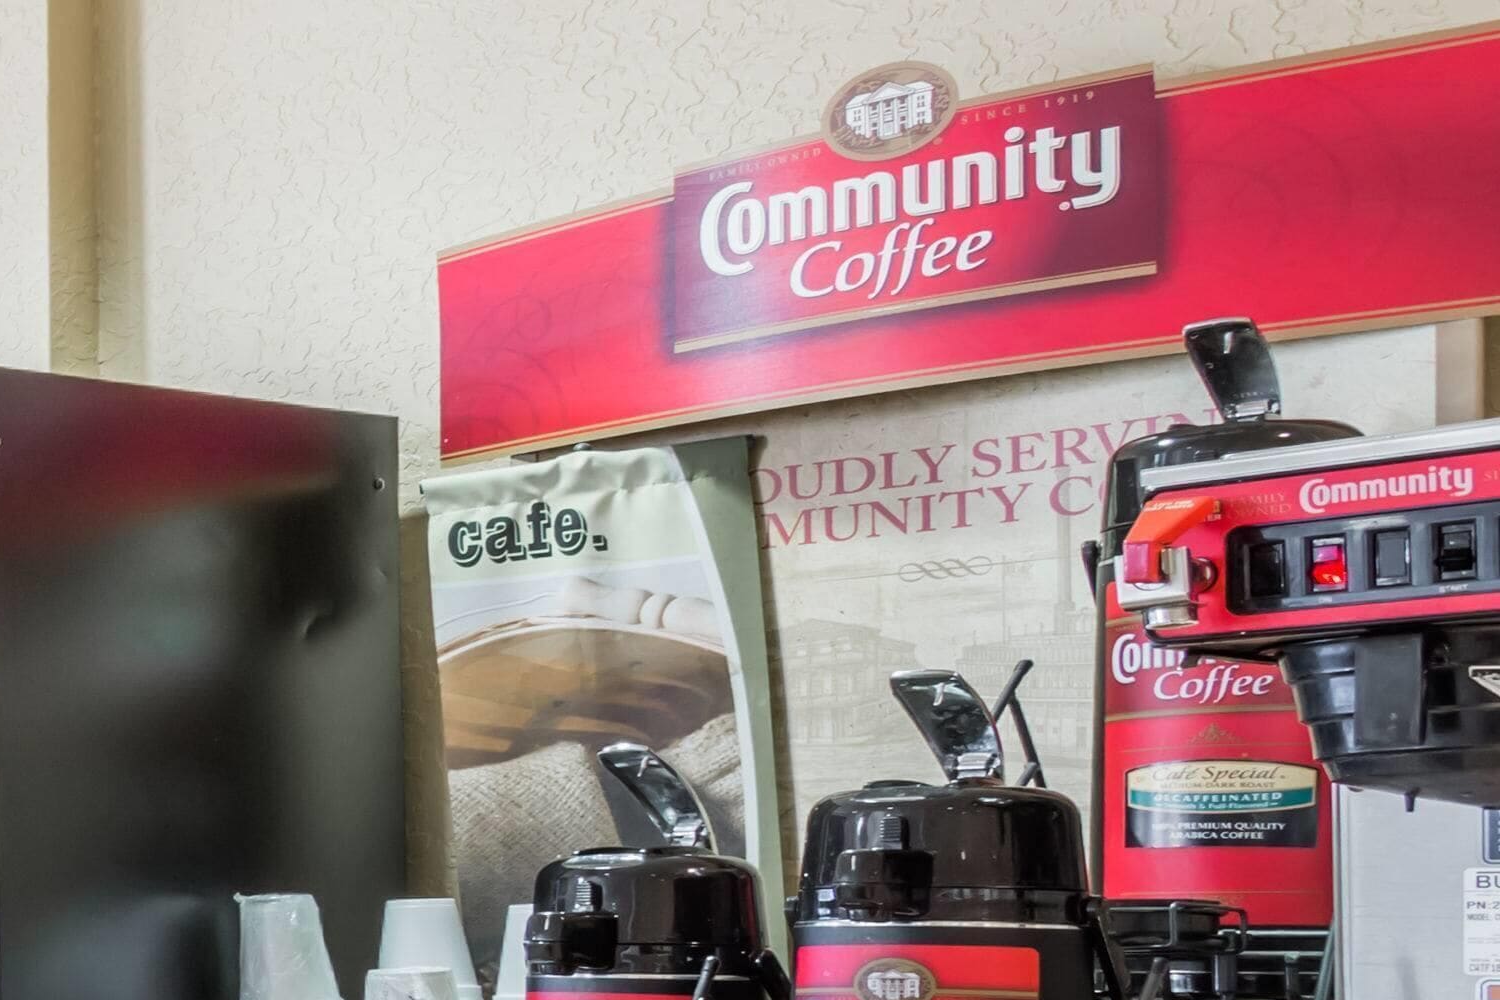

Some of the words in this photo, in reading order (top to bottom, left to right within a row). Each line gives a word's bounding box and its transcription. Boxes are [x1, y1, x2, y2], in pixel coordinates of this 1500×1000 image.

[961, 104, 1027, 125] SINCE
[1043, 90, 1095, 109] 1919
[708, 162, 761, 182] FAMILY
[767, 147, 822, 168] OWNED
[700, 126, 1121, 277] Community
[789, 218, 994, 299] Coffee
[1298, 465, 1473, 514] Community
[1153, 665, 1274, 704] Coffee
[1202, 766, 1280, 782] Special
[1153, 791, 1284, 804] DECAFFEINATED
[1169, 831, 1217, 840] ARABICA
[1219, 831, 1265, 840] COFFEE
[1178, 822, 1232, 831] PREMIUM
[1234, 822, 1287, 831] QUALITY
